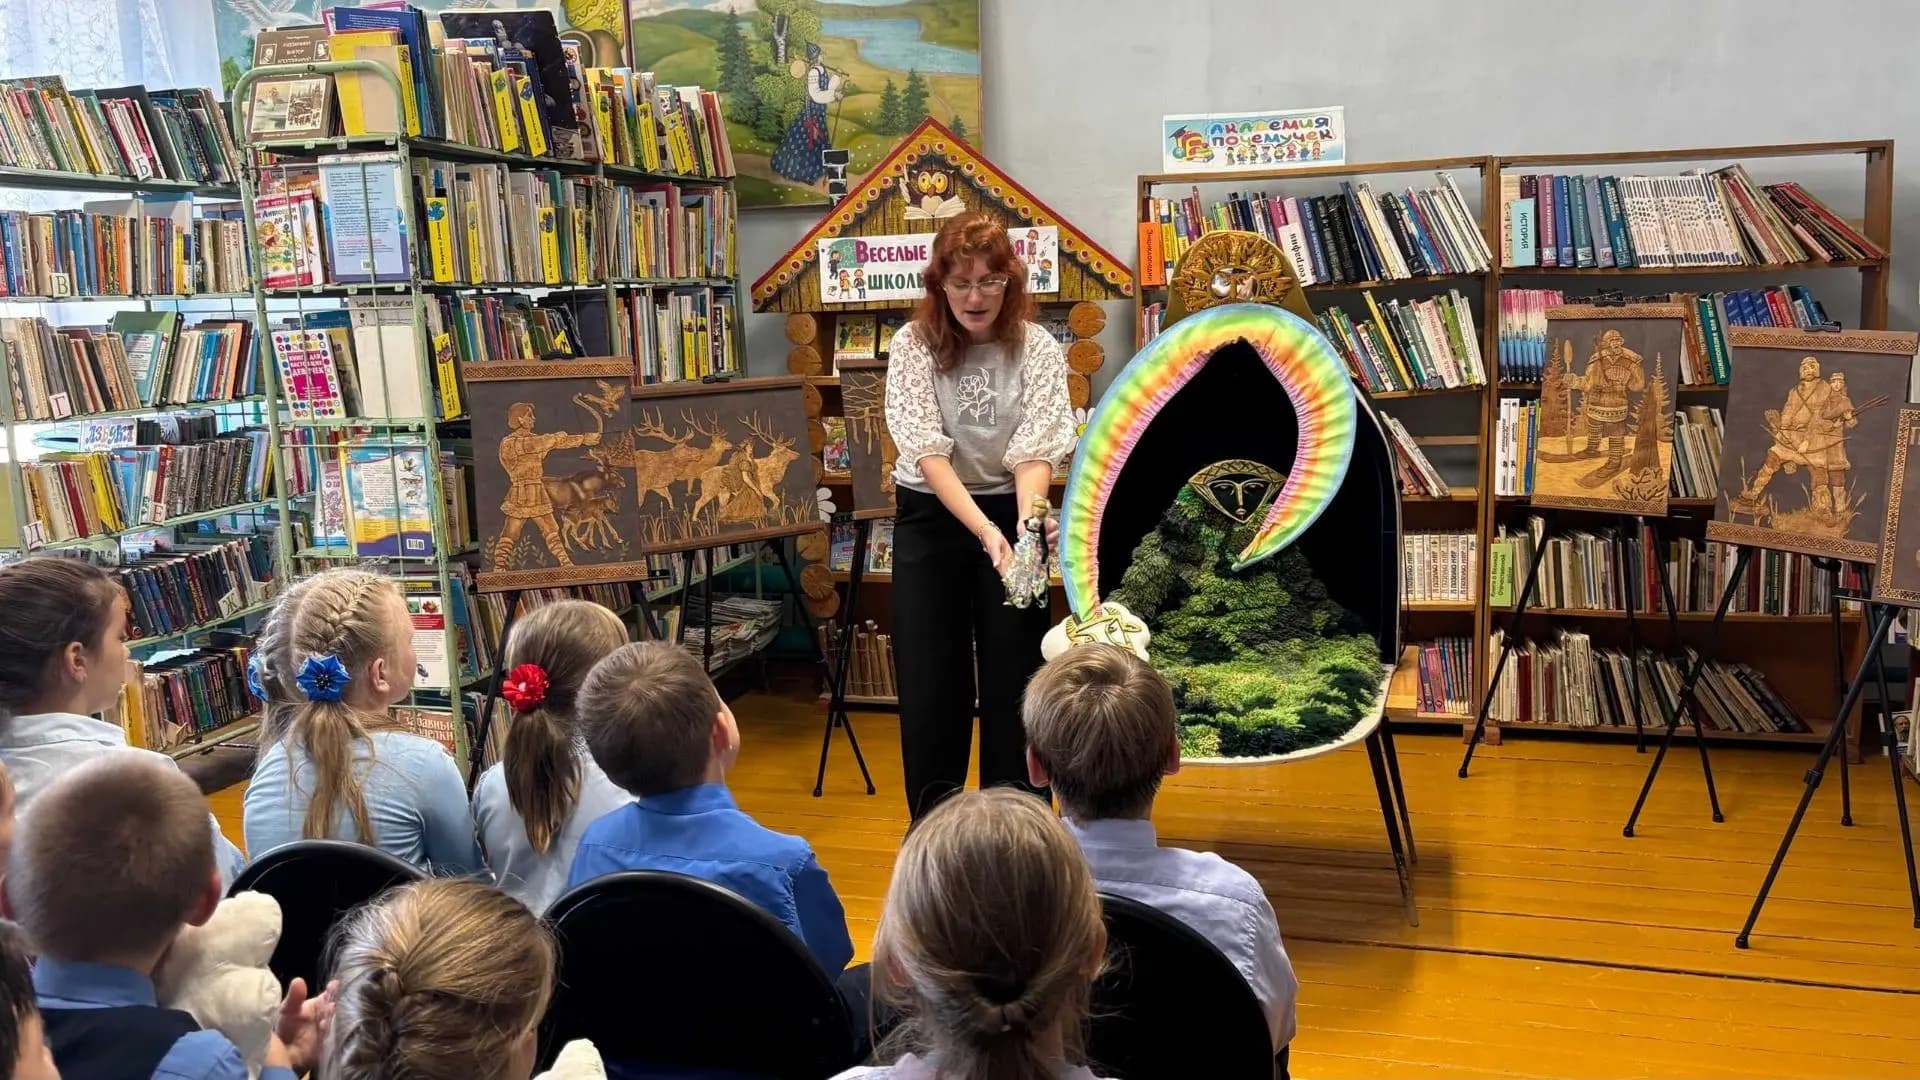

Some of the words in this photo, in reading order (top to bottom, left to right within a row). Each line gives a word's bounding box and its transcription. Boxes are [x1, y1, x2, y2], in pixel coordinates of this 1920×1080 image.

[139, 155, 149, 176] Б
[1520, 212, 1528, 249] ИСТОРИЯ
[54, 276, 68, 295] В
[867, 272, 926, 290] ШКОЛЬ
[54, 395, 68, 416] Г
[27, 522, 43, 548] Д
